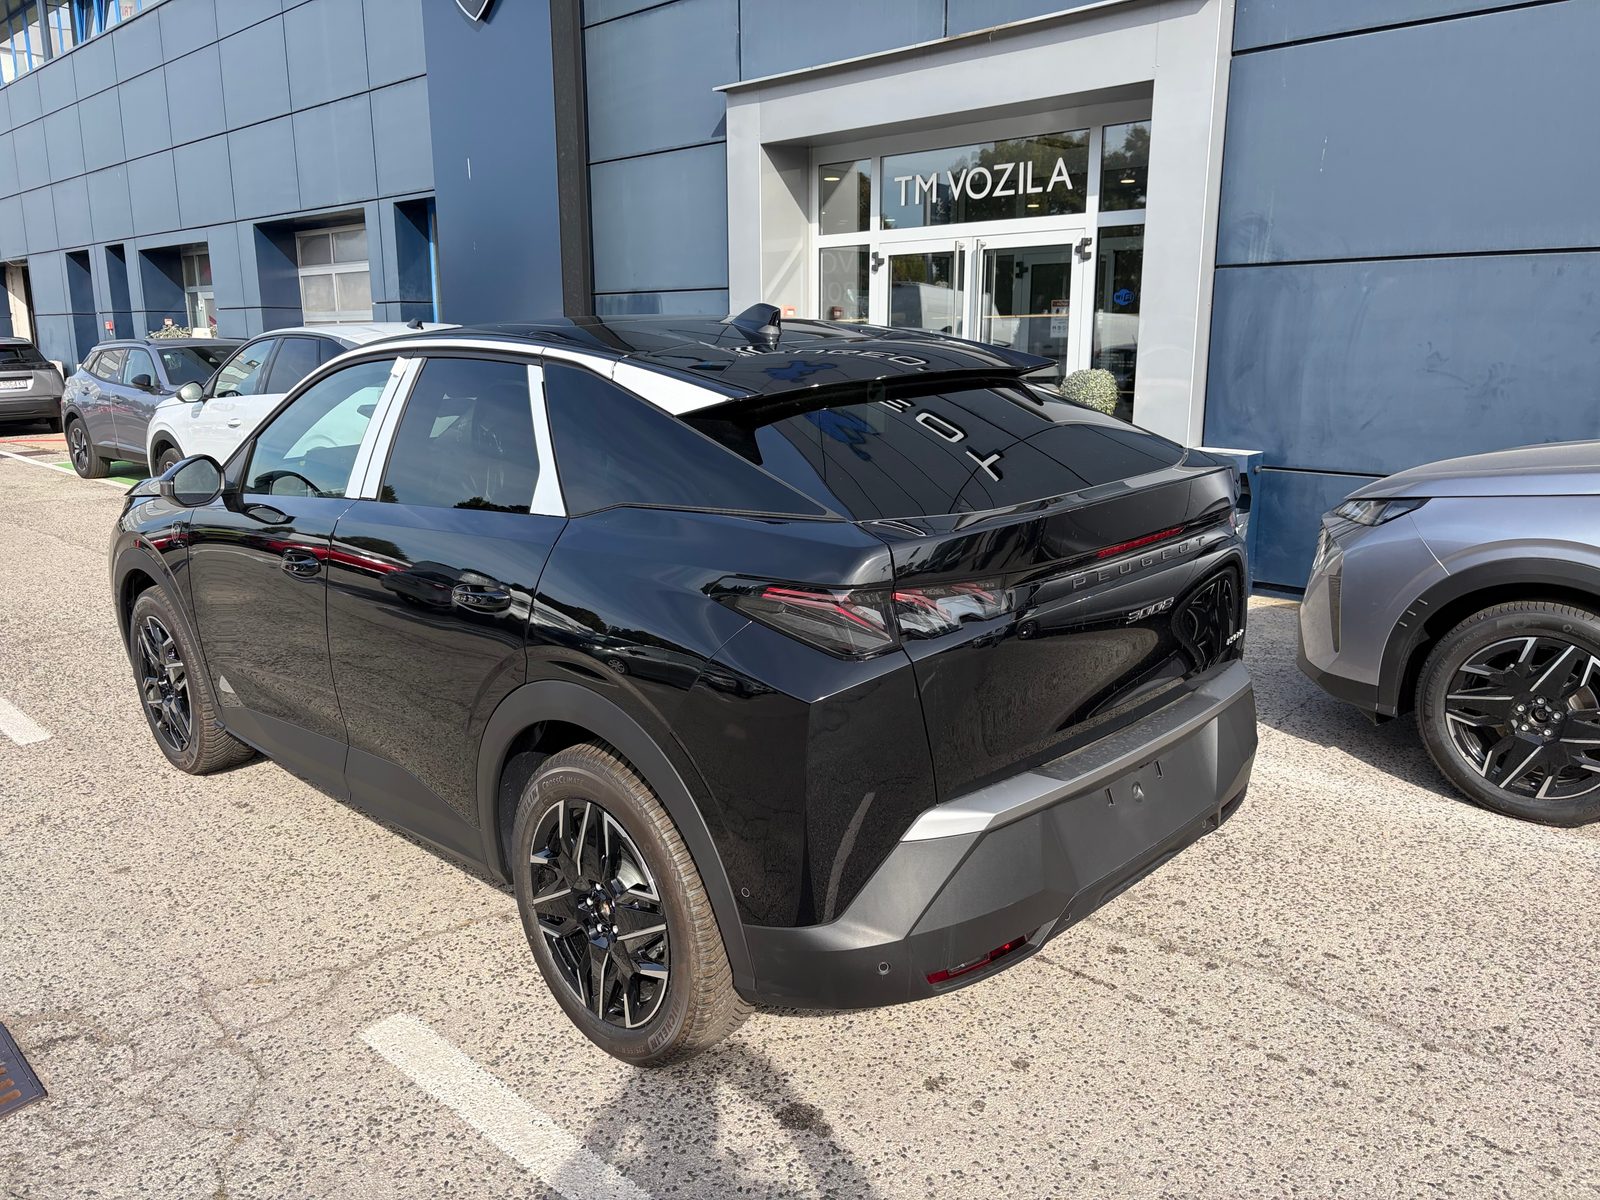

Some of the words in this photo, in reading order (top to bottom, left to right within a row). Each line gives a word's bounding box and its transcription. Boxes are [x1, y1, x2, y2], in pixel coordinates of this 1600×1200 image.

[894, 172, 938, 207] TM
[946, 156, 1074, 202] VOZILA
[1071, 535, 1206, 590] PEUGEOT
[1126, 596, 1175, 625] 3008
[649, 996, 682, 1050] MICHELIN
